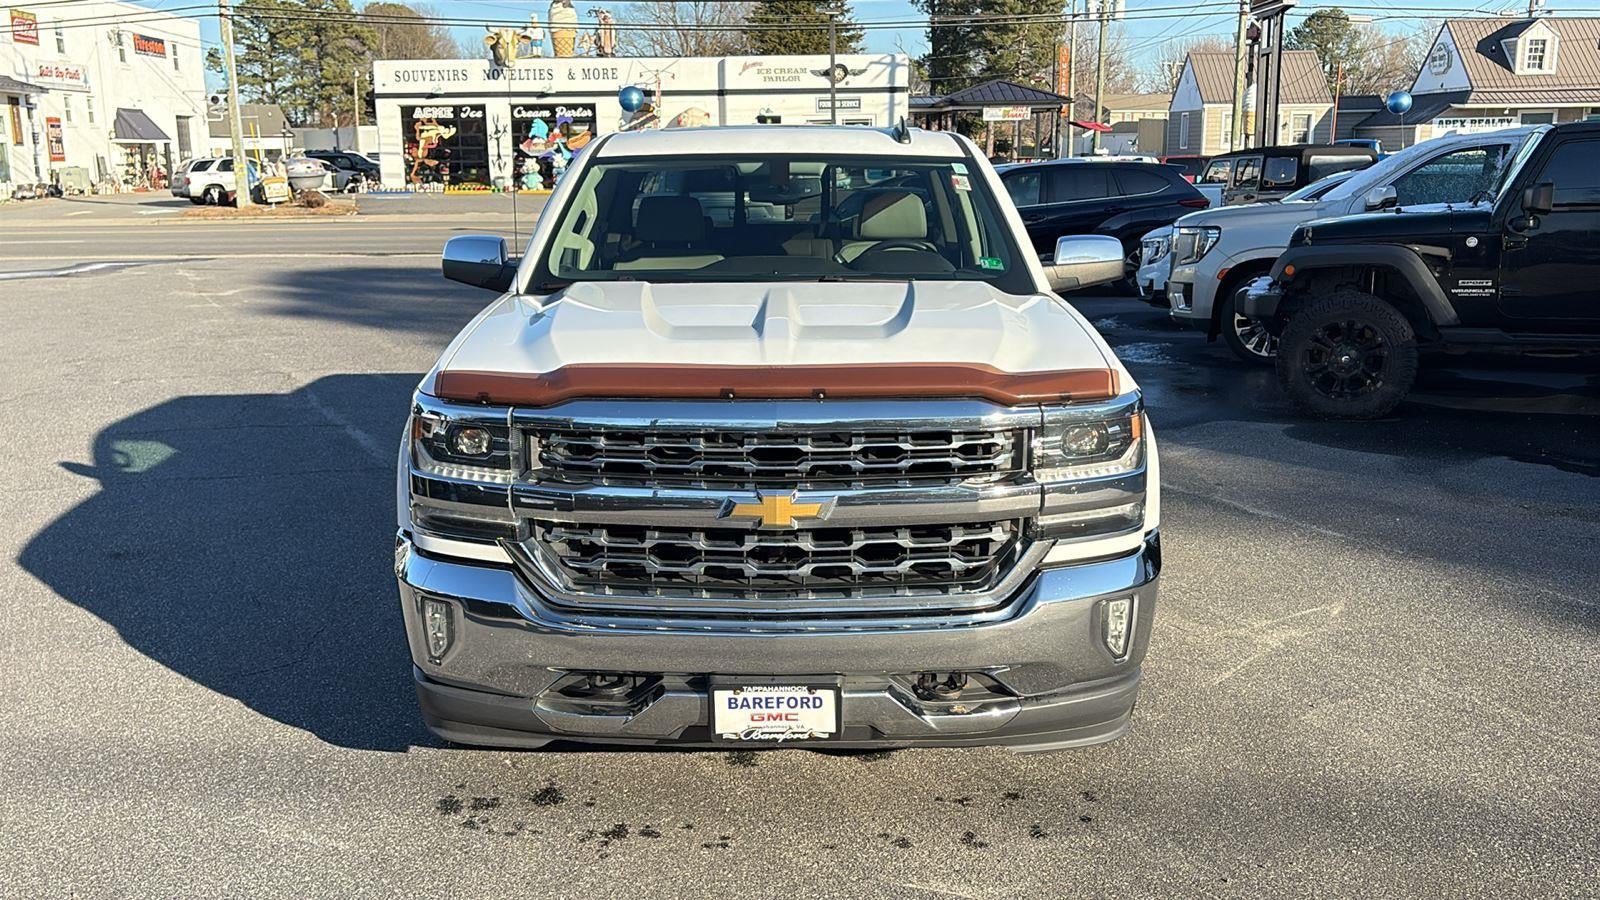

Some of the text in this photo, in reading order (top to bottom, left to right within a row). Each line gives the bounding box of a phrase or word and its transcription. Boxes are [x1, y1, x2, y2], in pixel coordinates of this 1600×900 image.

[394, 67, 619, 82] SOUVENIRS NOVELTIES & MORE
[773, 67, 808, 75] CREAM
[763, 75, 801, 83] PARLOR
[412, 107, 484, 119] ACME Ice
[513, 106, 593, 118] Cream Parlor
[1437, 118, 1513, 128] APEX REALTY
[727, 697, 823, 709] BAREFORD
[750, 713, 799, 721] GMC
[740, 727, 814, 743] Bareford
